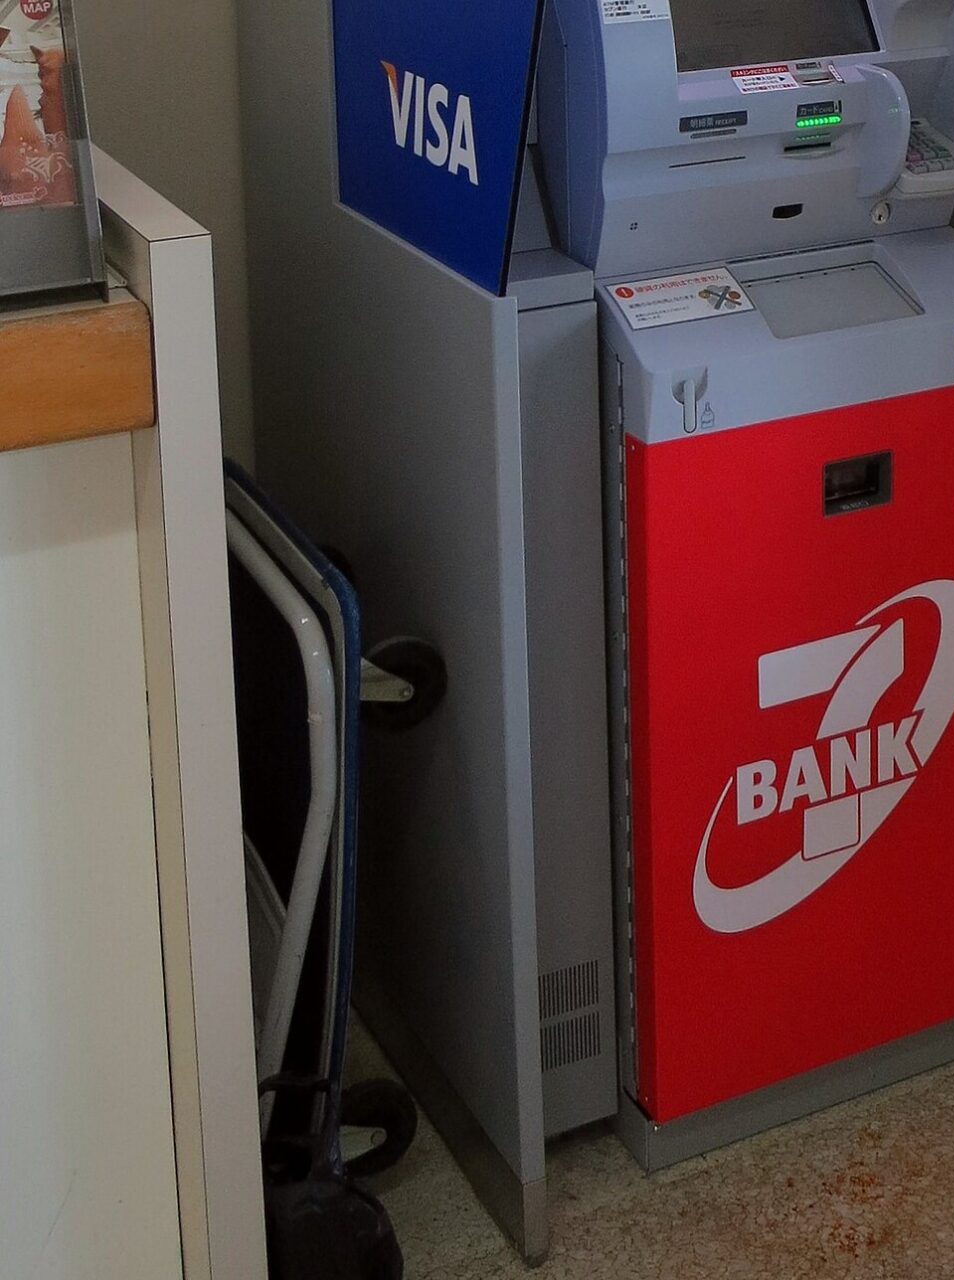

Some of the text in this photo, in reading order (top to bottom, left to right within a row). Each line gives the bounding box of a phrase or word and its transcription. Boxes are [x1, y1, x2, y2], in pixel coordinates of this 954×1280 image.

[22, 1, 52, 14] MAP
[380, 60, 479, 186] VISA
[736, 714, 919, 826] BANK
